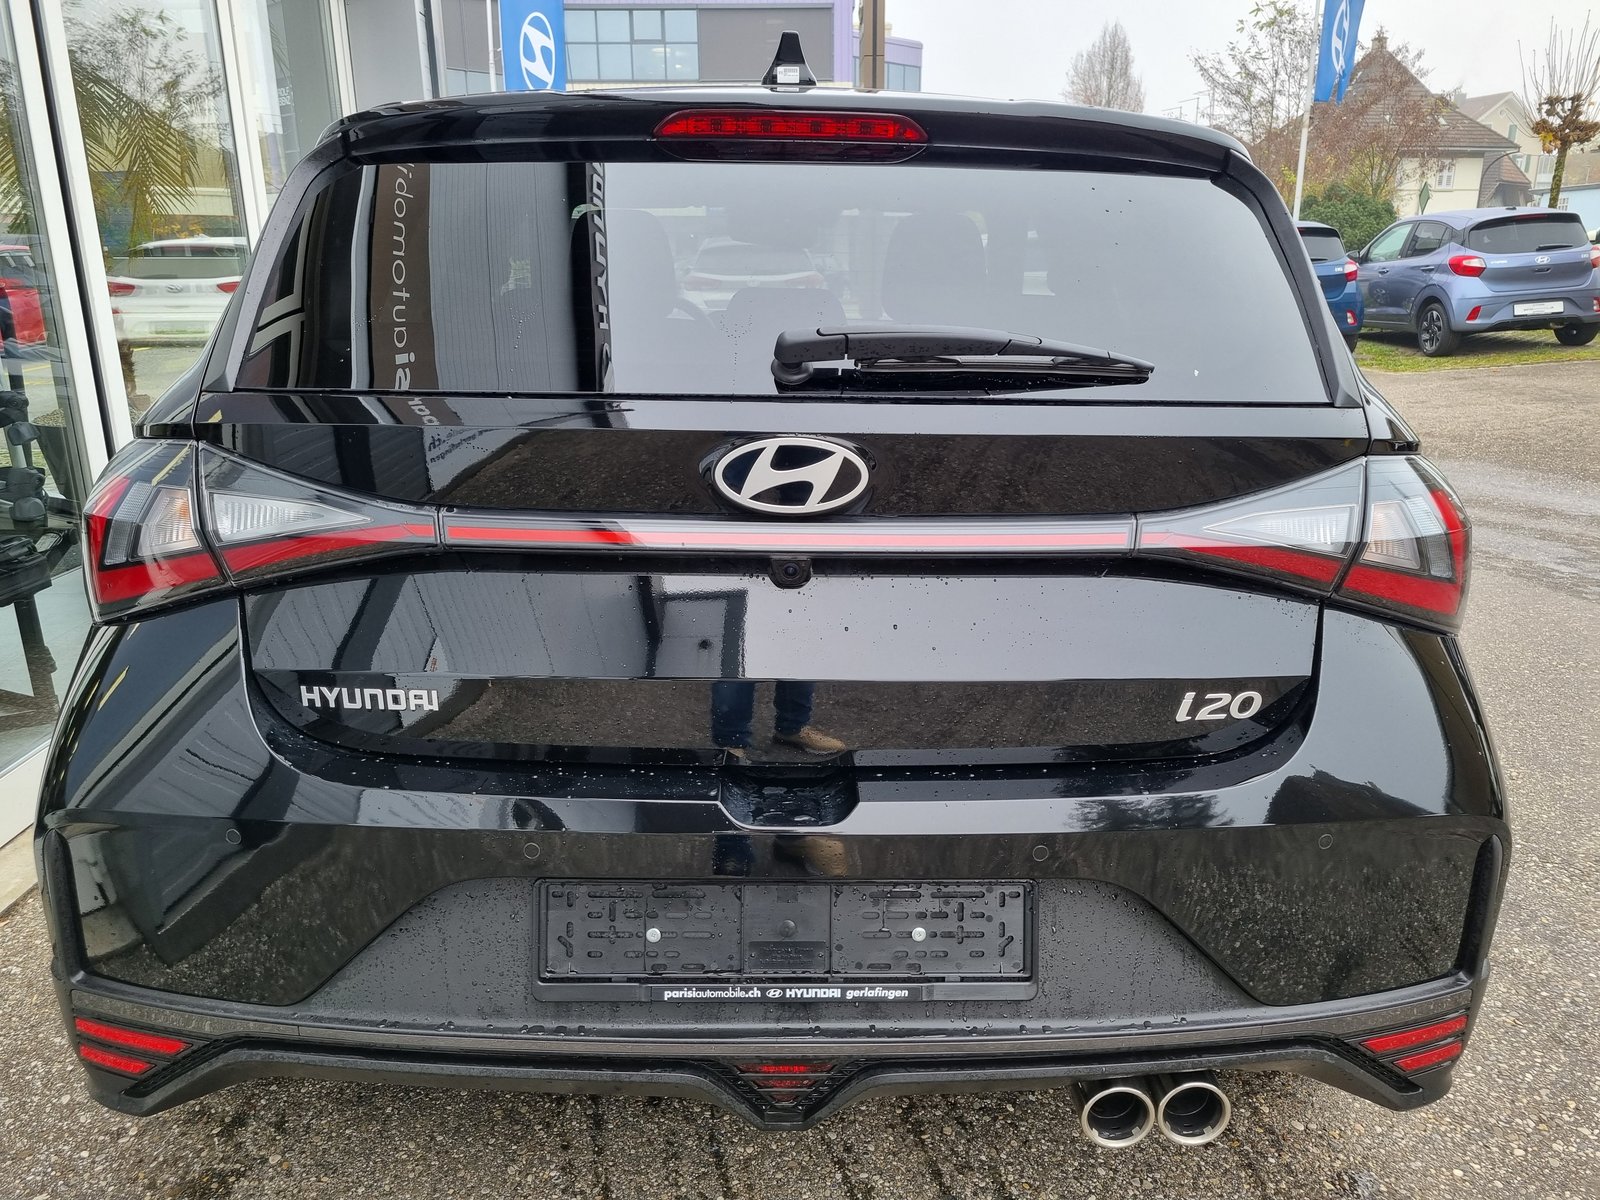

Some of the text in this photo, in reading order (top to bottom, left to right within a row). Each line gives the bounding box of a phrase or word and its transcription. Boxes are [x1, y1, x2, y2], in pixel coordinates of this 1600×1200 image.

[300, 685, 439, 711] HYUNDAI
[1175, 691, 1263, 722] i20
[664, 987, 909, 1001] parisiautomobile.ch HYUNDAI gerlafingen
